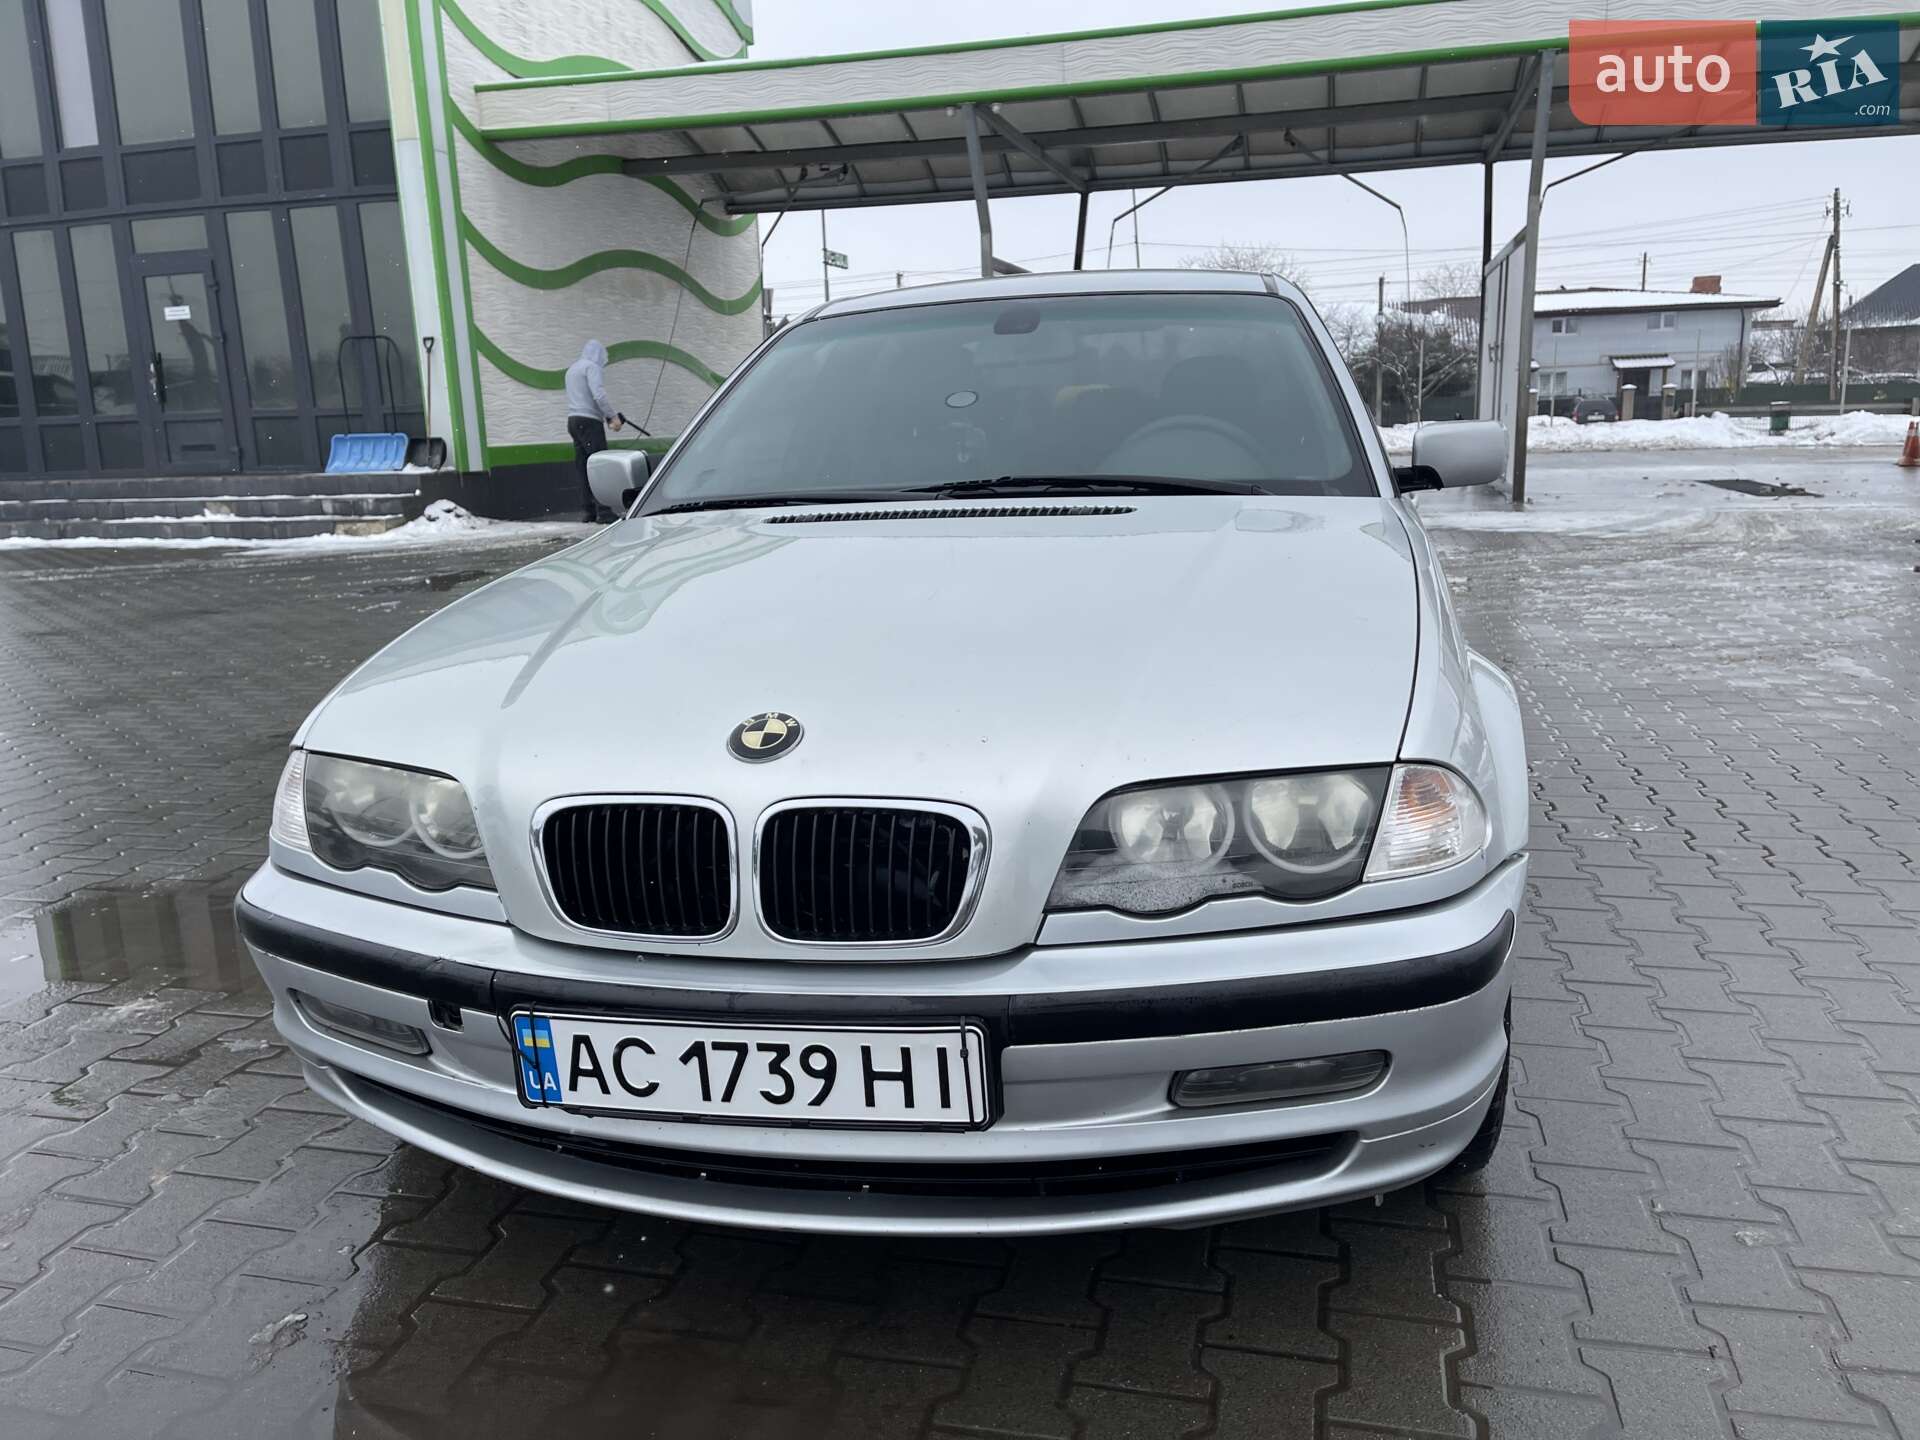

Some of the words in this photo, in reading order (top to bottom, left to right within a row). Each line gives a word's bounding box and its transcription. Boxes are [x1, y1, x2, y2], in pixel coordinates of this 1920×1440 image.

[742, 712, 798, 727] BMW
[529, 1071, 557, 1091] UA
[569, 1034, 660, 1098] AC
[678, 1040, 838, 1106] 1739
[860, 1044, 951, 1109] HI
